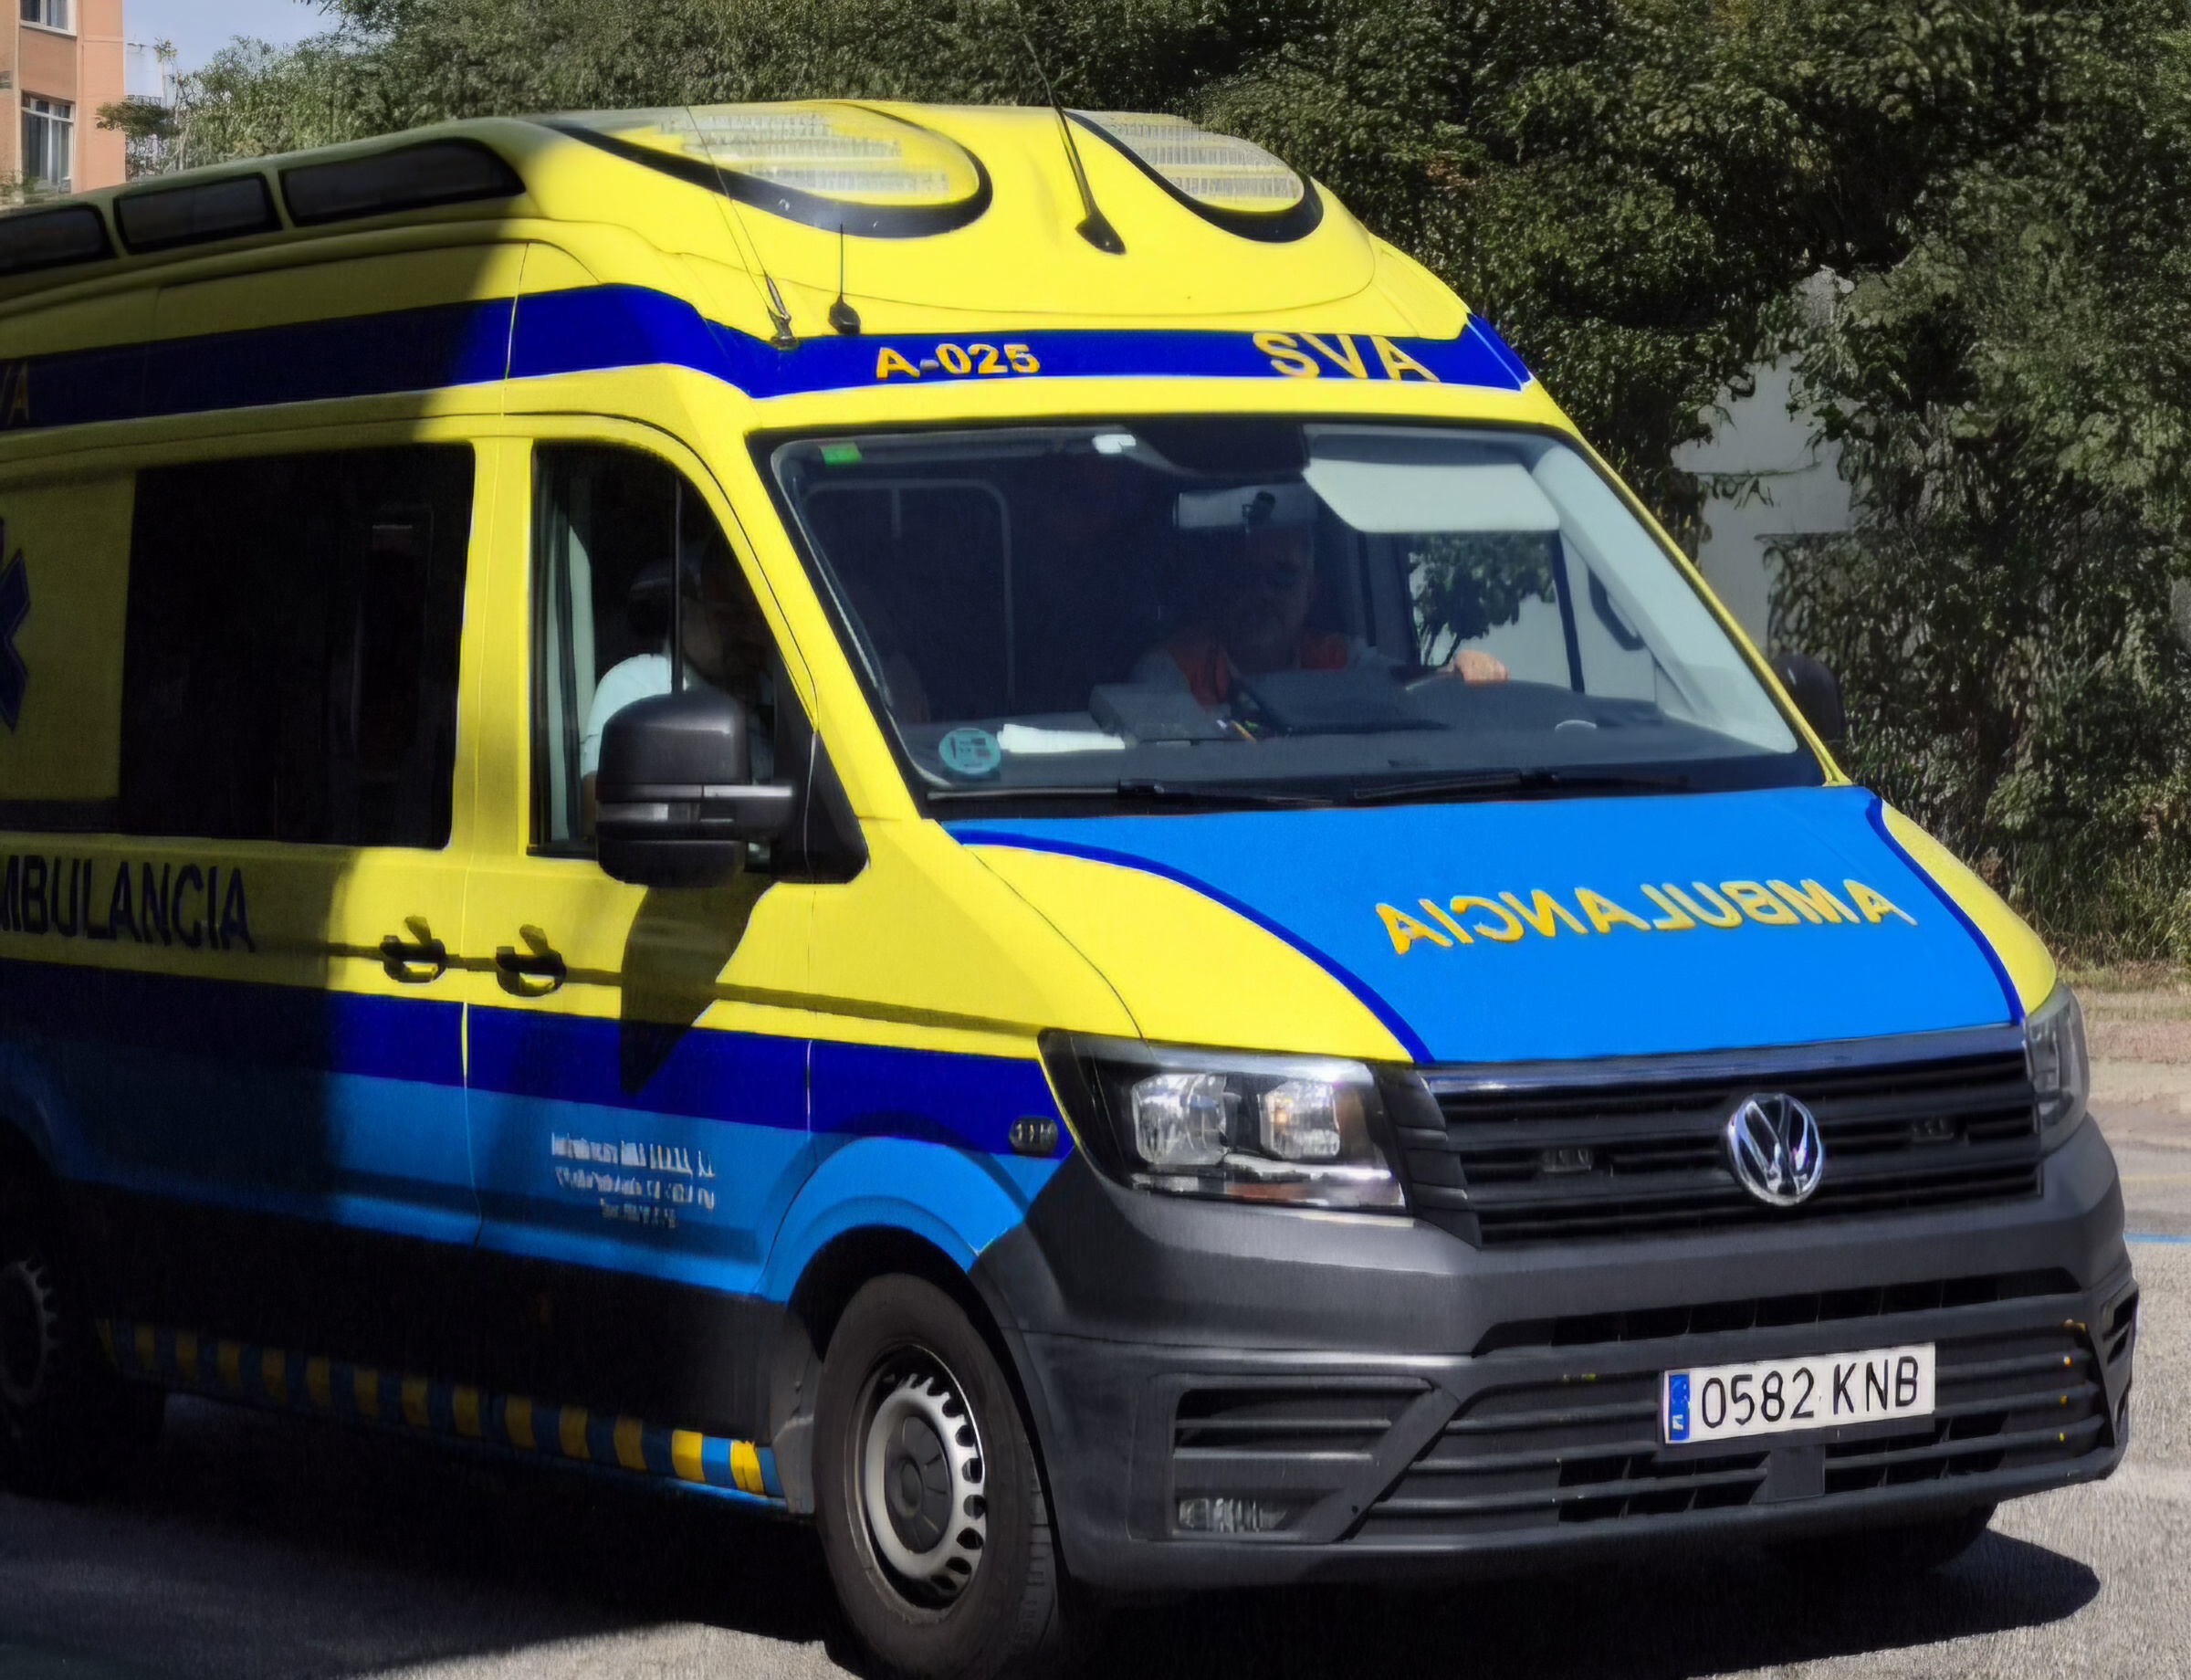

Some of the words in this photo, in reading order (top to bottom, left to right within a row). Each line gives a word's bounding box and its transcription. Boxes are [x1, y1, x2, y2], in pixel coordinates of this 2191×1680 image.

[876, 343, 1041, 380] A-025
[1253, 331, 1441, 383] SVA
[1701, 1367, 1815, 1429] 0582
[1832, 1355, 1919, 1415] KNB
